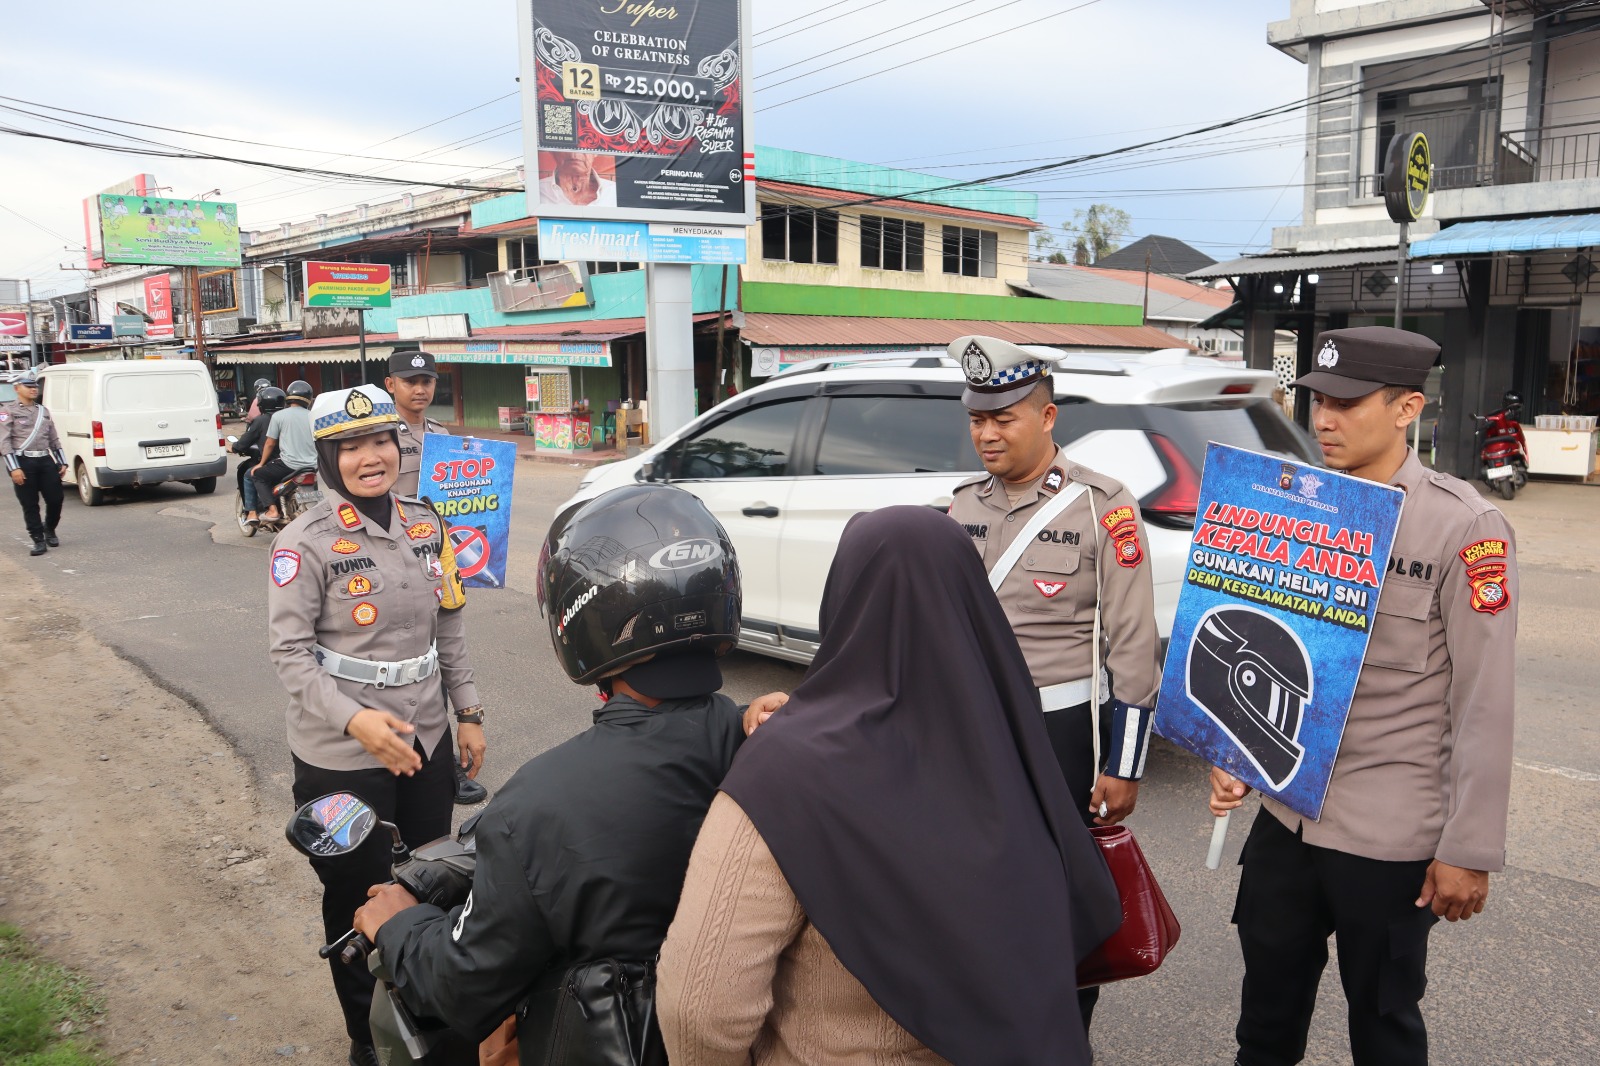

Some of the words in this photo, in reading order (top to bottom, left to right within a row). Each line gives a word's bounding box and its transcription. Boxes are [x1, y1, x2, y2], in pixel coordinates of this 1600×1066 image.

[594, 30, 687, 51] CELEBRATION
[592, 45, 609, 57] OF
[614, 47, 690, 65] GREATNESS
[569, 67, 594, 90] 12
[569, 89, 594, 97] BATANG
[605, 73, 621, 88] Rp
[624, 75, 707, 103] 25.000,-
[692, 126, 735, 141] RASANYA
[700, 140, 735, 154] SUPER
[660, 169, 704, 179] PERINGATAN:
[550, 224, 641, 247] Freshmart
[673, 227, 723, 236] MENYEDIAKAN
[330, 271, 369, 280] WARMINDO
[560, 343, 603, 354] WARMINDO
[431, 457, 496, 482] STOP
[439, 478, 492, 490] PENGGUNAAN
[447, 487, 482, 497] KNALPOT
[433, 494, 500, 516] BRONG
[1284, 492, 1306, 504] POLRES
[1203, 502, 1374, 555] LINDUNGILAH
[1038, 529, 1081, 546] OLRI
[668, 544, 711, 562] GM
[1194, 523, 1290, 566] KEPALA
[1295, 546, 1380, 587] ANDA
[1465, 540, 1503, 557] POLRES
[330, 556, 377, 576] YUNITA
[1192, 549, 1274, 583] GUNAKAN
[1278, 569, 1329, 598] HELM
[1334, 586, 1367, 607] SNI
[1188, 568, 1220, 587] DEMI
[1222, 575, 1322, 615] KESELAMATAN
[1323, 606, 1367, 628] ANDA
[655, 625, 664, 634] M
